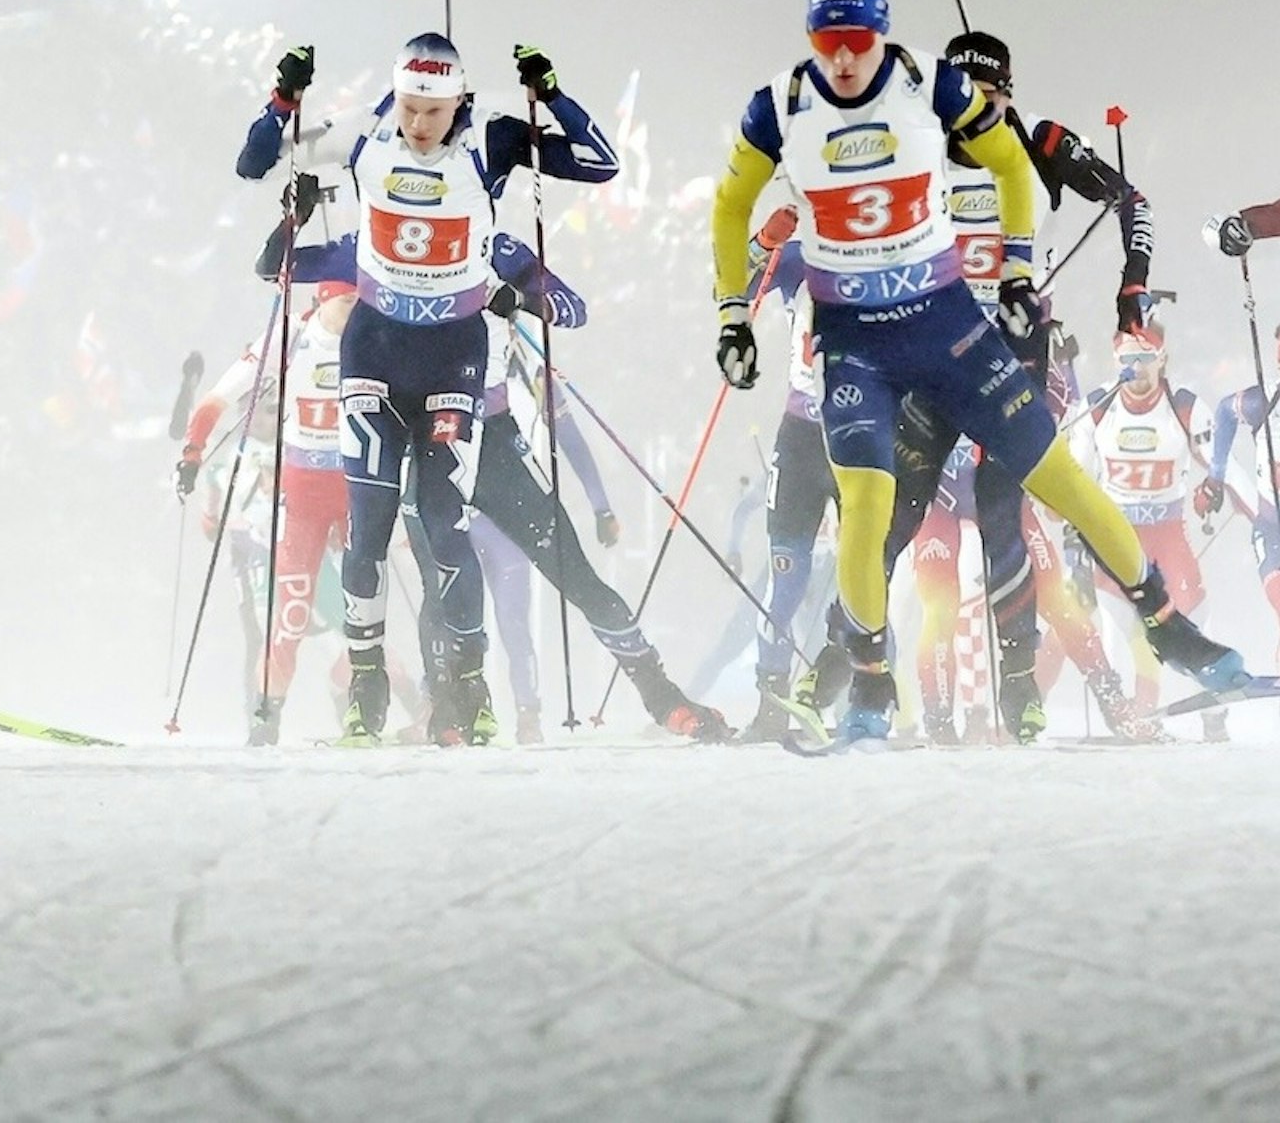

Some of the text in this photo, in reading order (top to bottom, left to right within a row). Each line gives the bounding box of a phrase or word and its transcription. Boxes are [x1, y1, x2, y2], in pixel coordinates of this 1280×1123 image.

[847, 186, 924, 235] 3 1
[392, 219, 462, 261] 8 1
[963, 238, 1000, 274] 5
[408, 295, 458, 322] iX2
[1111, 464, 1153, 489] 21
[275, 573, 311, 645] POL
